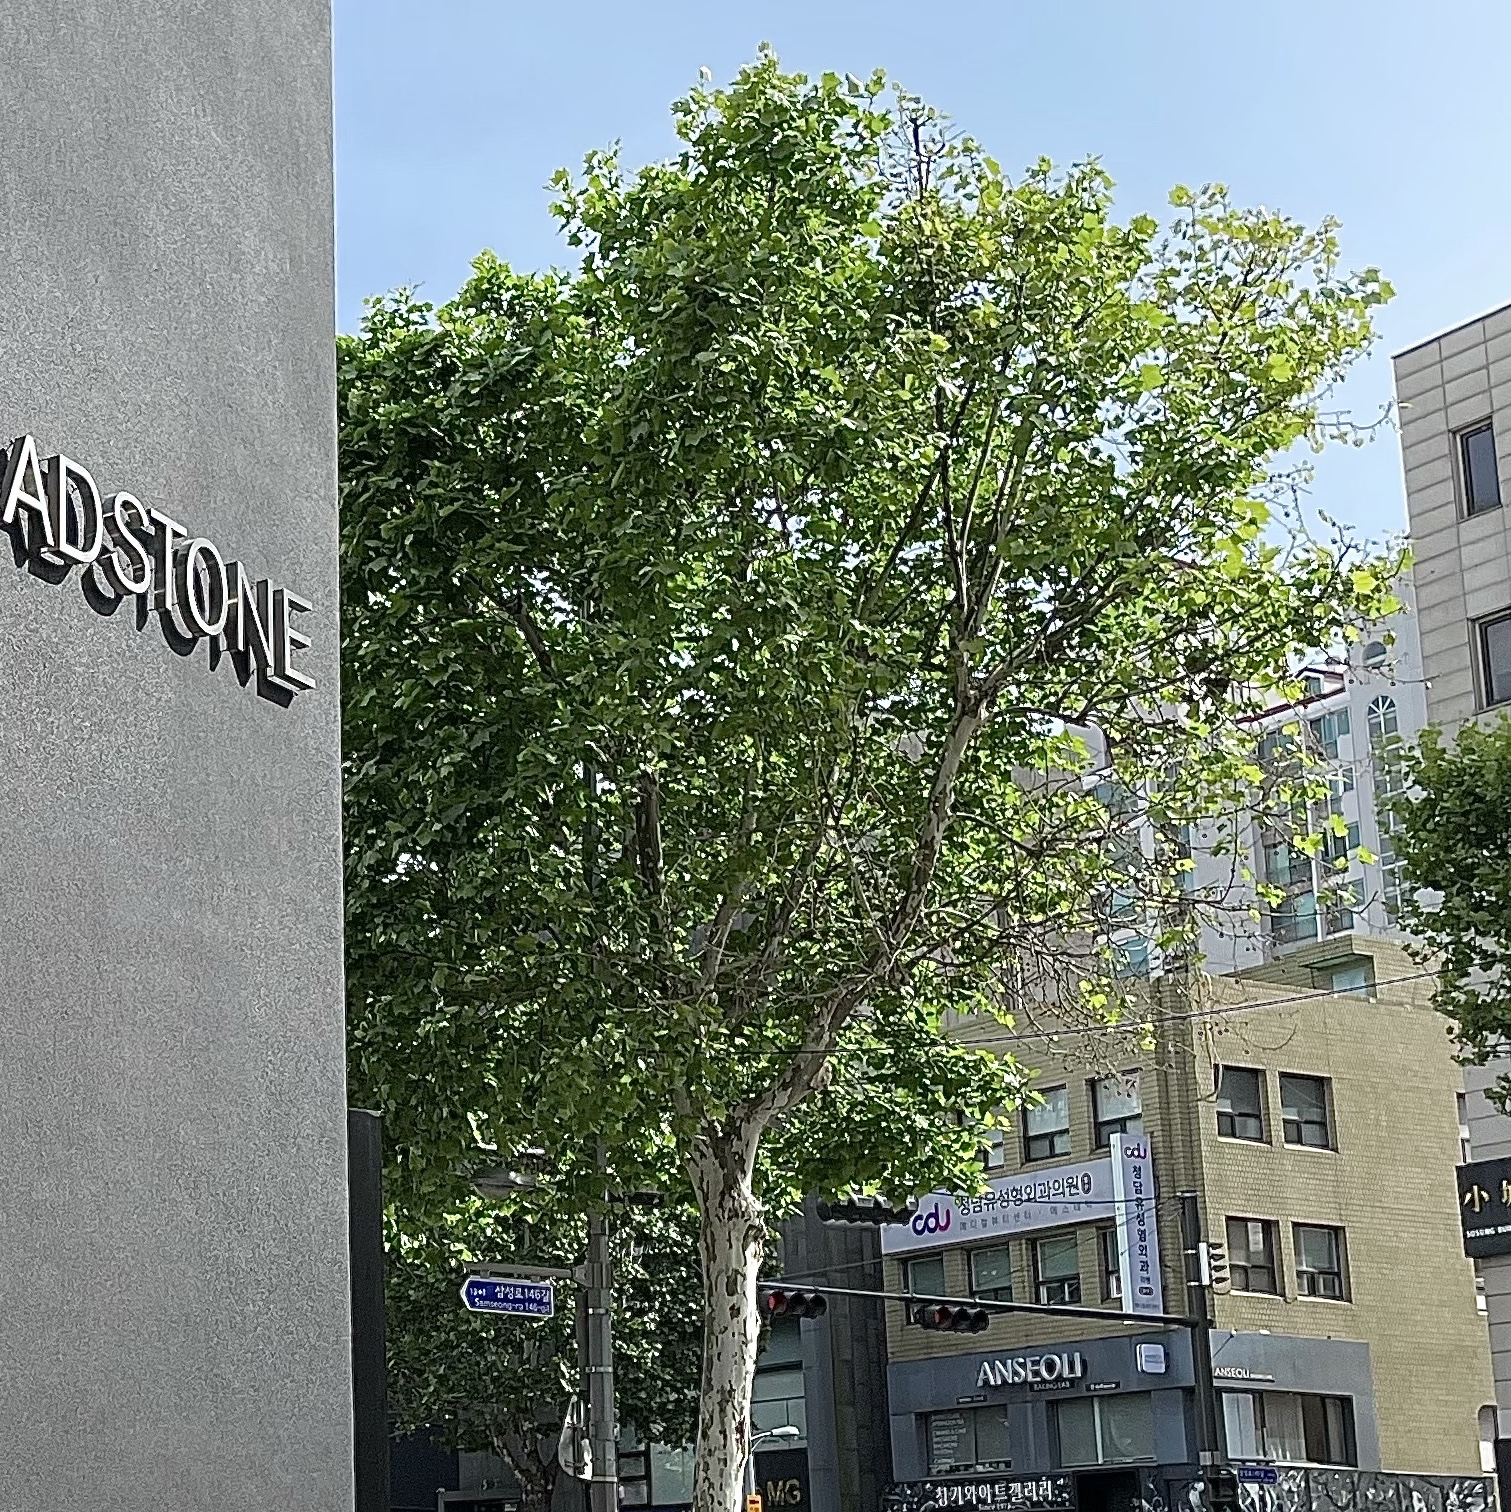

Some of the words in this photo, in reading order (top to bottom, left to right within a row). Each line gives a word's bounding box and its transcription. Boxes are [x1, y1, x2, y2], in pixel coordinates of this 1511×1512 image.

[912, 1203, 951, 1236] cdu
[976, 1352, 1082, 1387] ANSEOLI
[766, 1478, 801, 1506] MG
